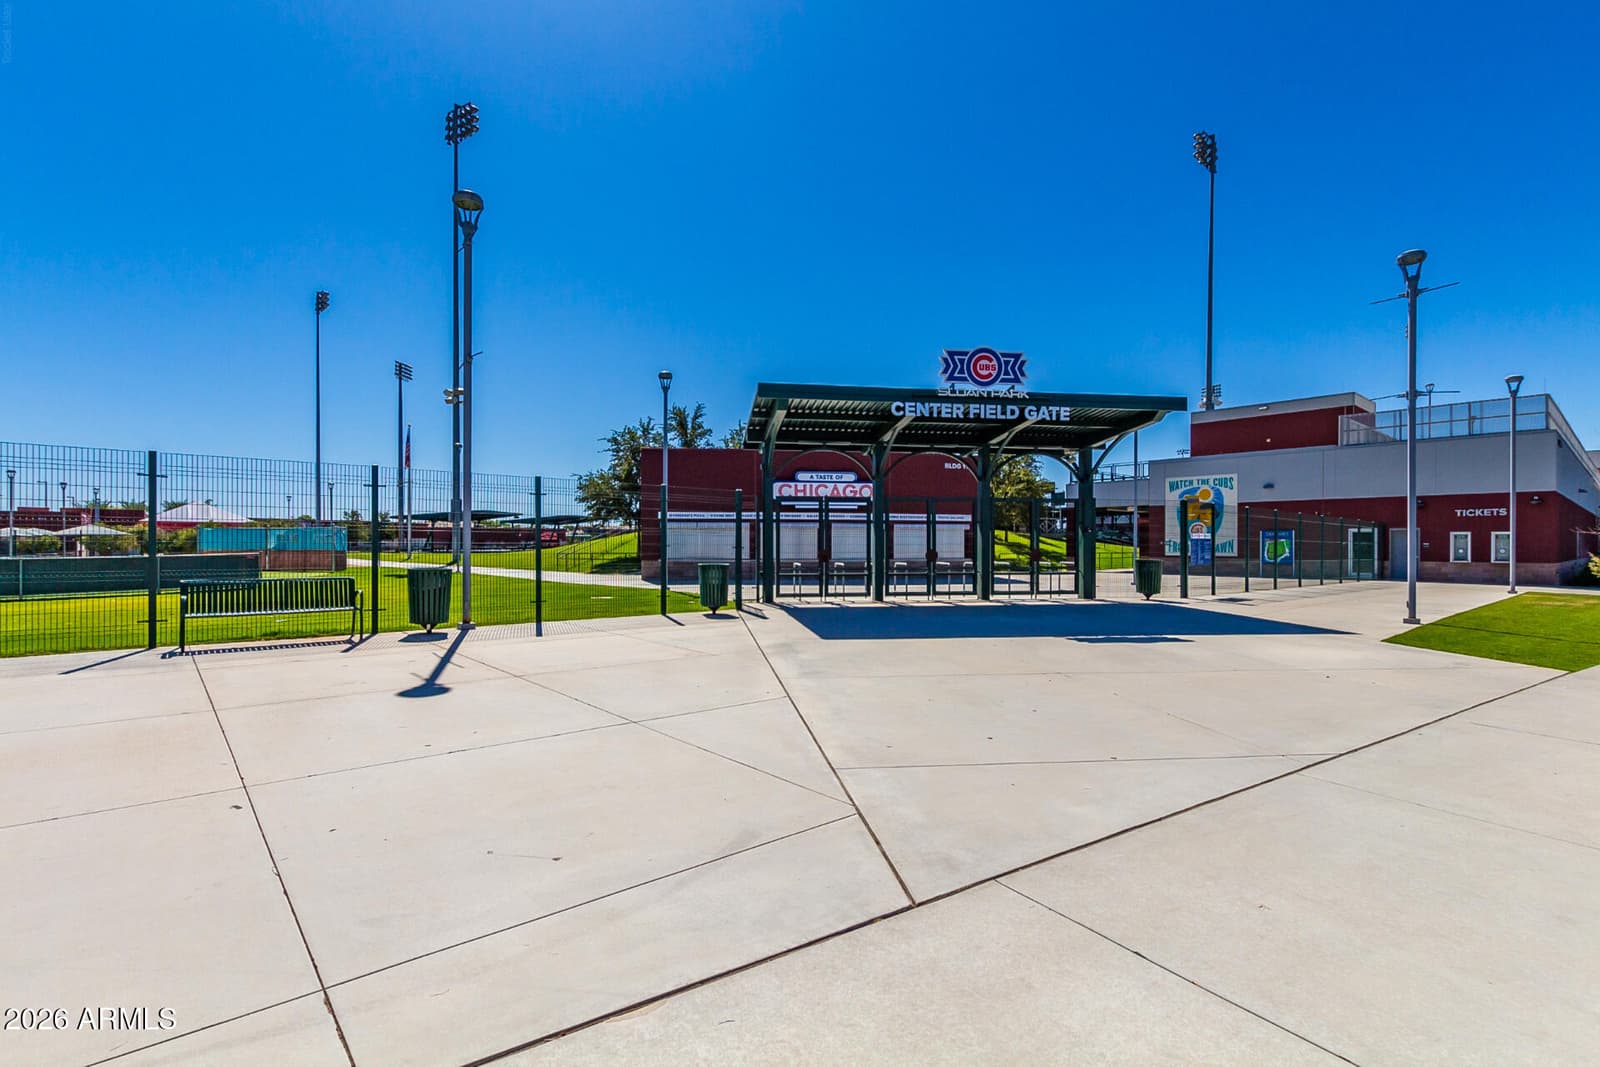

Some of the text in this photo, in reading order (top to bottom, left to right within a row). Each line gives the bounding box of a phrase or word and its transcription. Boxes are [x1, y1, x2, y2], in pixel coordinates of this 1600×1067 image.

[991, 389, 1029, 399] PARK
[891, 401, 1071, 421] CENTER FIELD GATE
[777, 483, 873, 497] CHICAGO
[1168, 476, 1234, 493] WATCH THE CUBS
[1454, 508, 1508, 517] TICKETS
[1214, 539, 1234, 553] AWN
